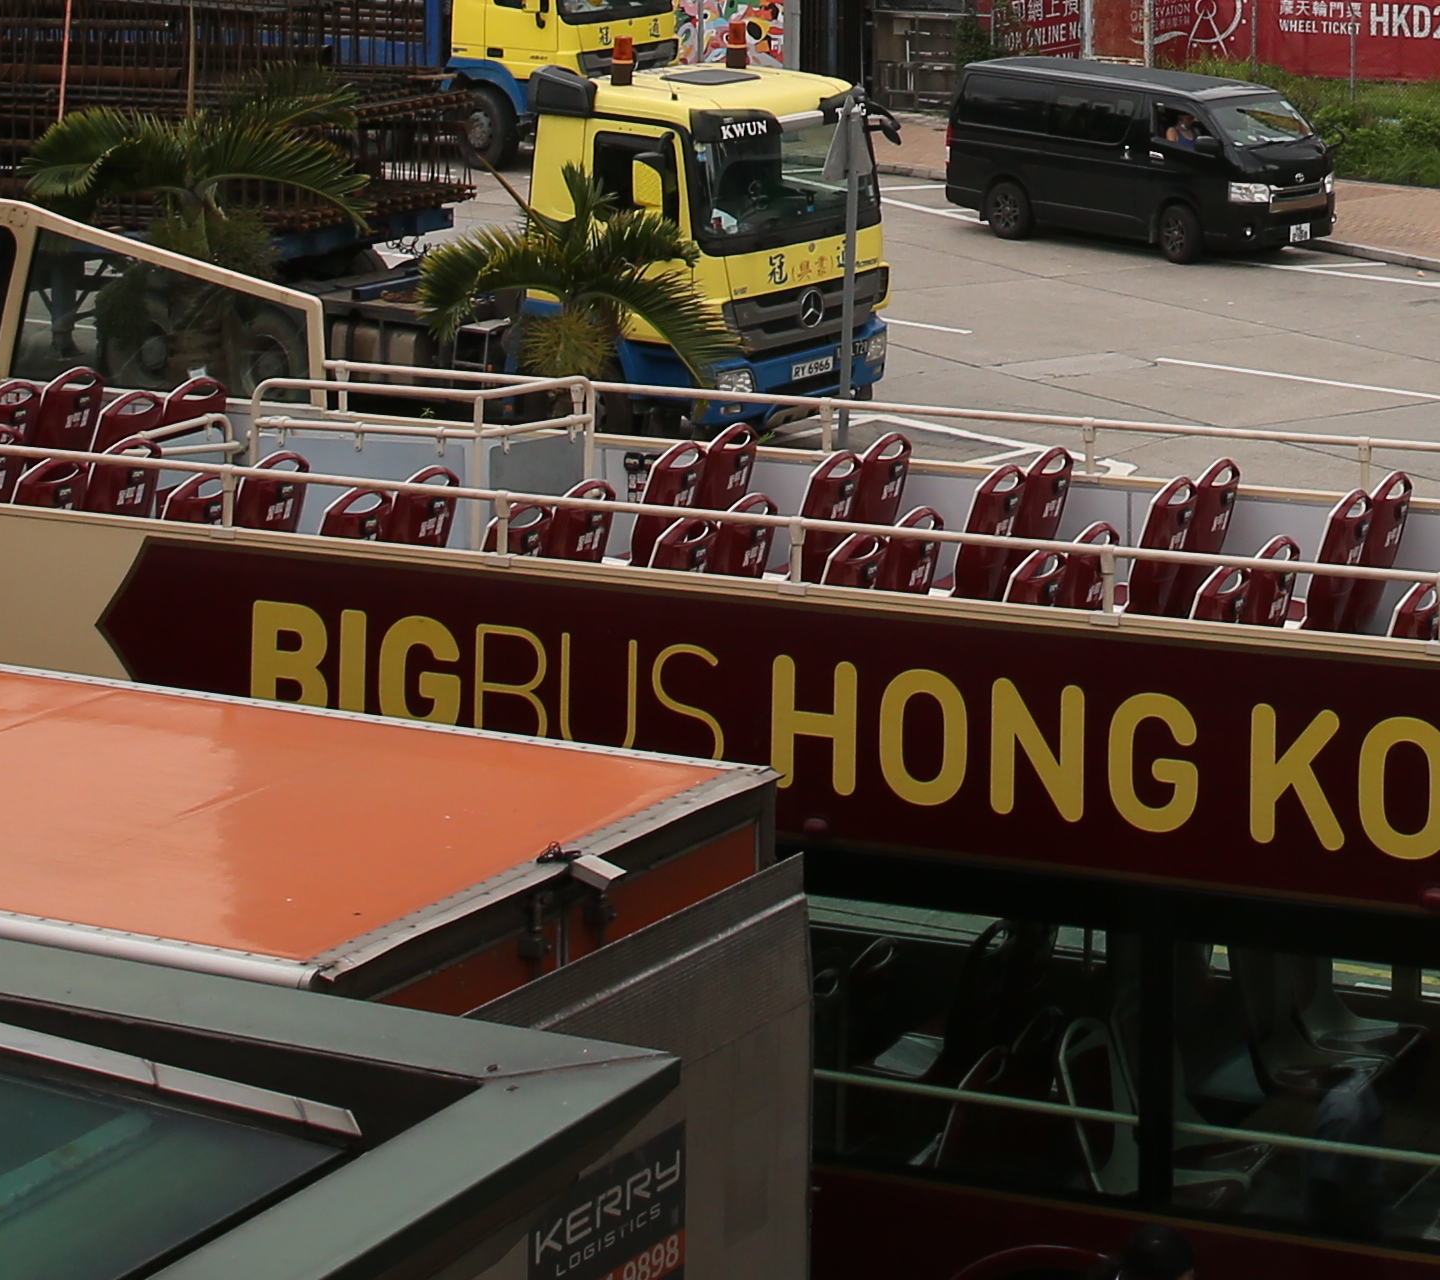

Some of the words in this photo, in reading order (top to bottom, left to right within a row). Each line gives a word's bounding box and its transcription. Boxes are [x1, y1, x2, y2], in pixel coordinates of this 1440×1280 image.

[1279, 0, 1363, 19] 摩天輪門票
[1026, 25, 1067, 48] ONLINE
[1279, 19, 1319, 33] WHEEL
[1321, 20, 1361, 35] TICKET
[721, 119, 768, 140] KWUN
[793, 365, 808, 379] RY
[808, 361, 831, 376] 6966
[770, 655, 1199, 833] HONG
[535, 1149, 680, 1265] KERRY
[556, 1203, 660, 1277] LOGISTICS
